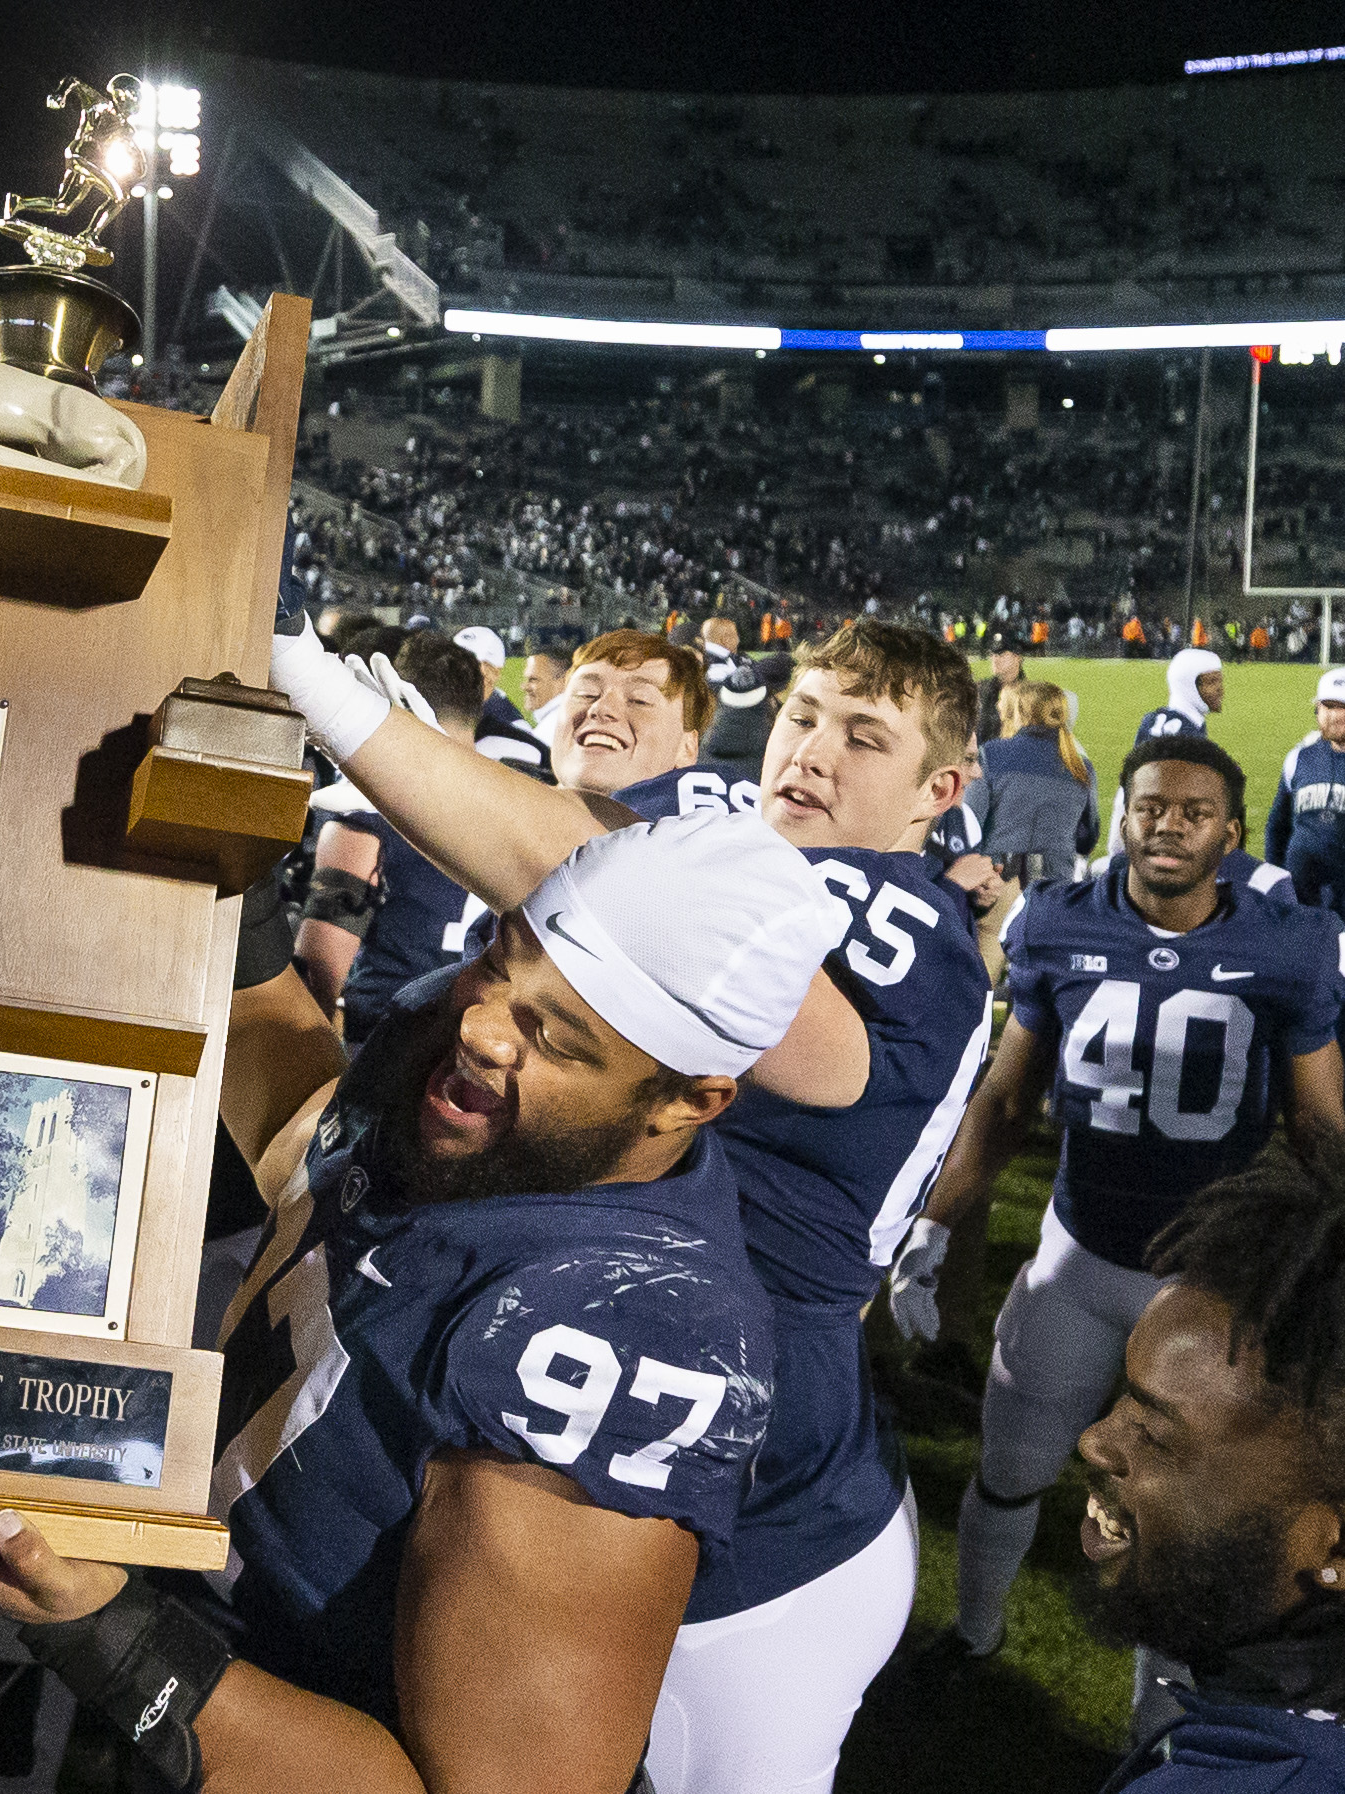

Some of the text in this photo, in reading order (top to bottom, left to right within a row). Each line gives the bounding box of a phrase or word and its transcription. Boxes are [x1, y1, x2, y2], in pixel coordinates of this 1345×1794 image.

[1064, 979, 1255, 1142] 40
[3, 1434, 49, 1456] STATE
[52, 1439, 128, 1464] UNIVERSITY
[19, 1376, 135, 1422] TROPHY
[501, 1323, 727, 1491] 97
